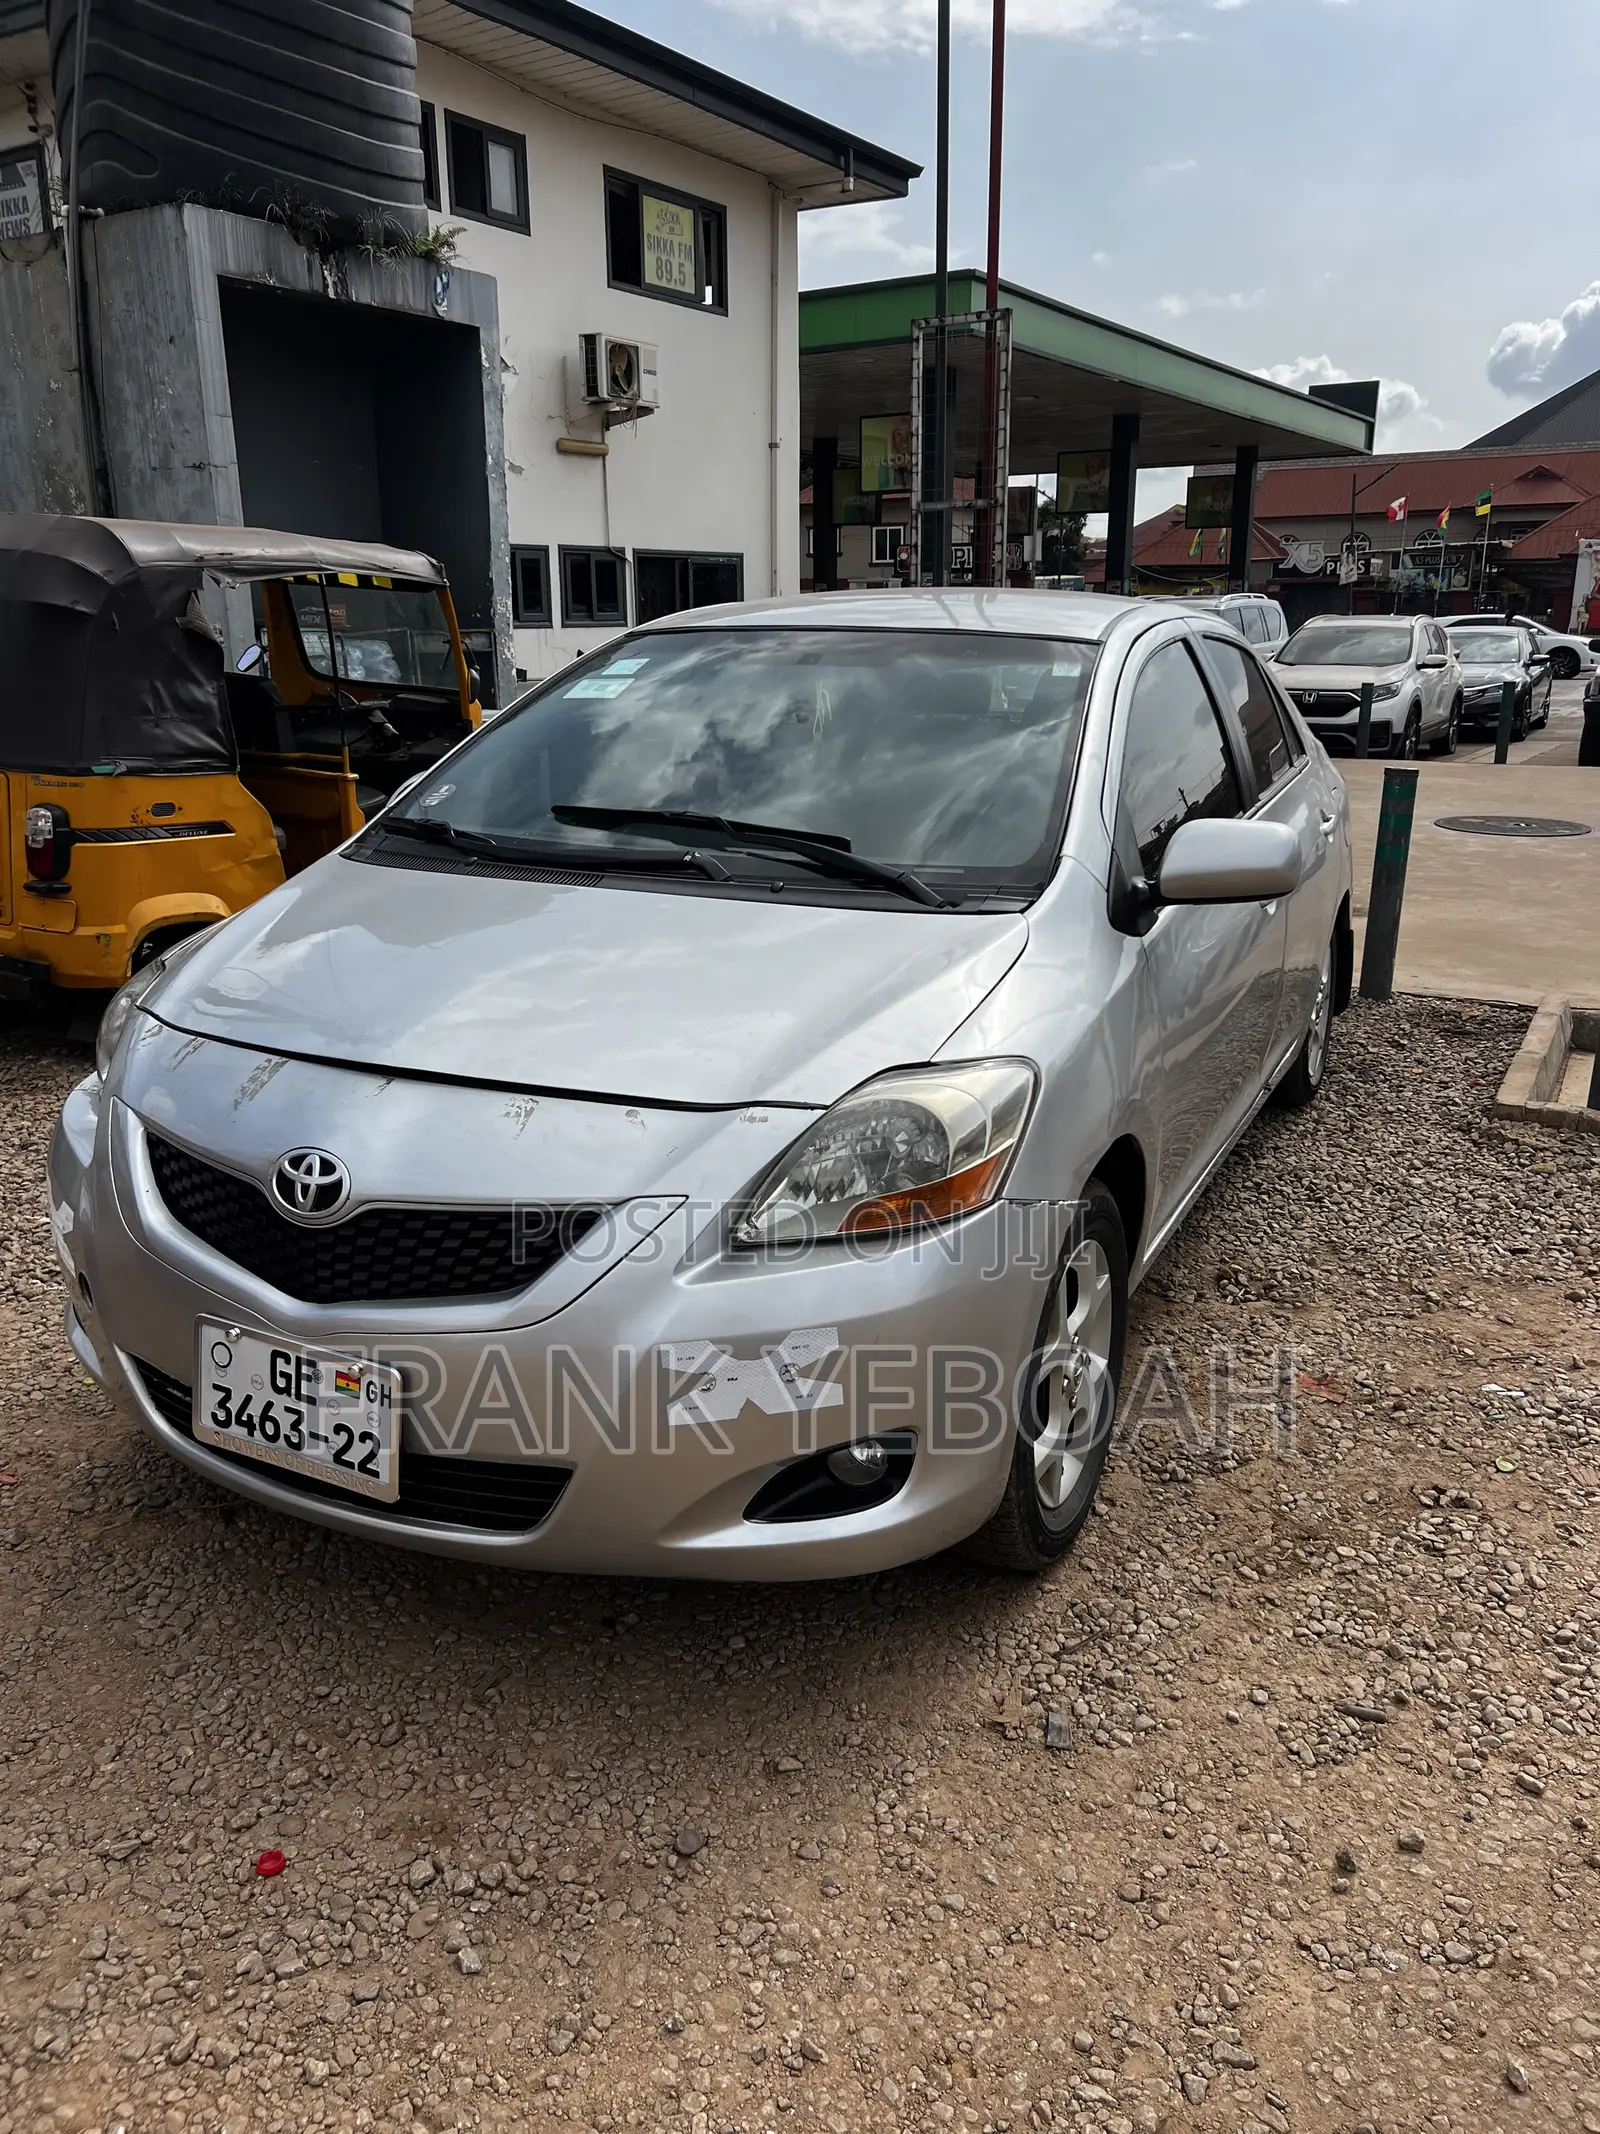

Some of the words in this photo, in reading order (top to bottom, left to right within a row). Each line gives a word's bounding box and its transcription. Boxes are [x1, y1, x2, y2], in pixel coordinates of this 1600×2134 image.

[0, 195, 30, 217] IKKA
[646, 233, 675, 258] SIKKA
[678, 242, 693, 264] FM
[656, 256, 686, 287] 89.5
[862, 453, 912, 469] WELCOM
[1279, 541, 1325, 574] X5
[1326, 560, 1365, 575] PLS
[179, 829, 209, 837] DELUXE
[270, 1349, 318, 1406] GE
[366, 1380, 391, 1409] GH
[211, 1383, 381, 1479] 3463-22
[213, 1431, 280, 1463] SHOWERS
[284, 1453, 301, 1470] OF
[305, 1460, 375, 1495] BLESSING
